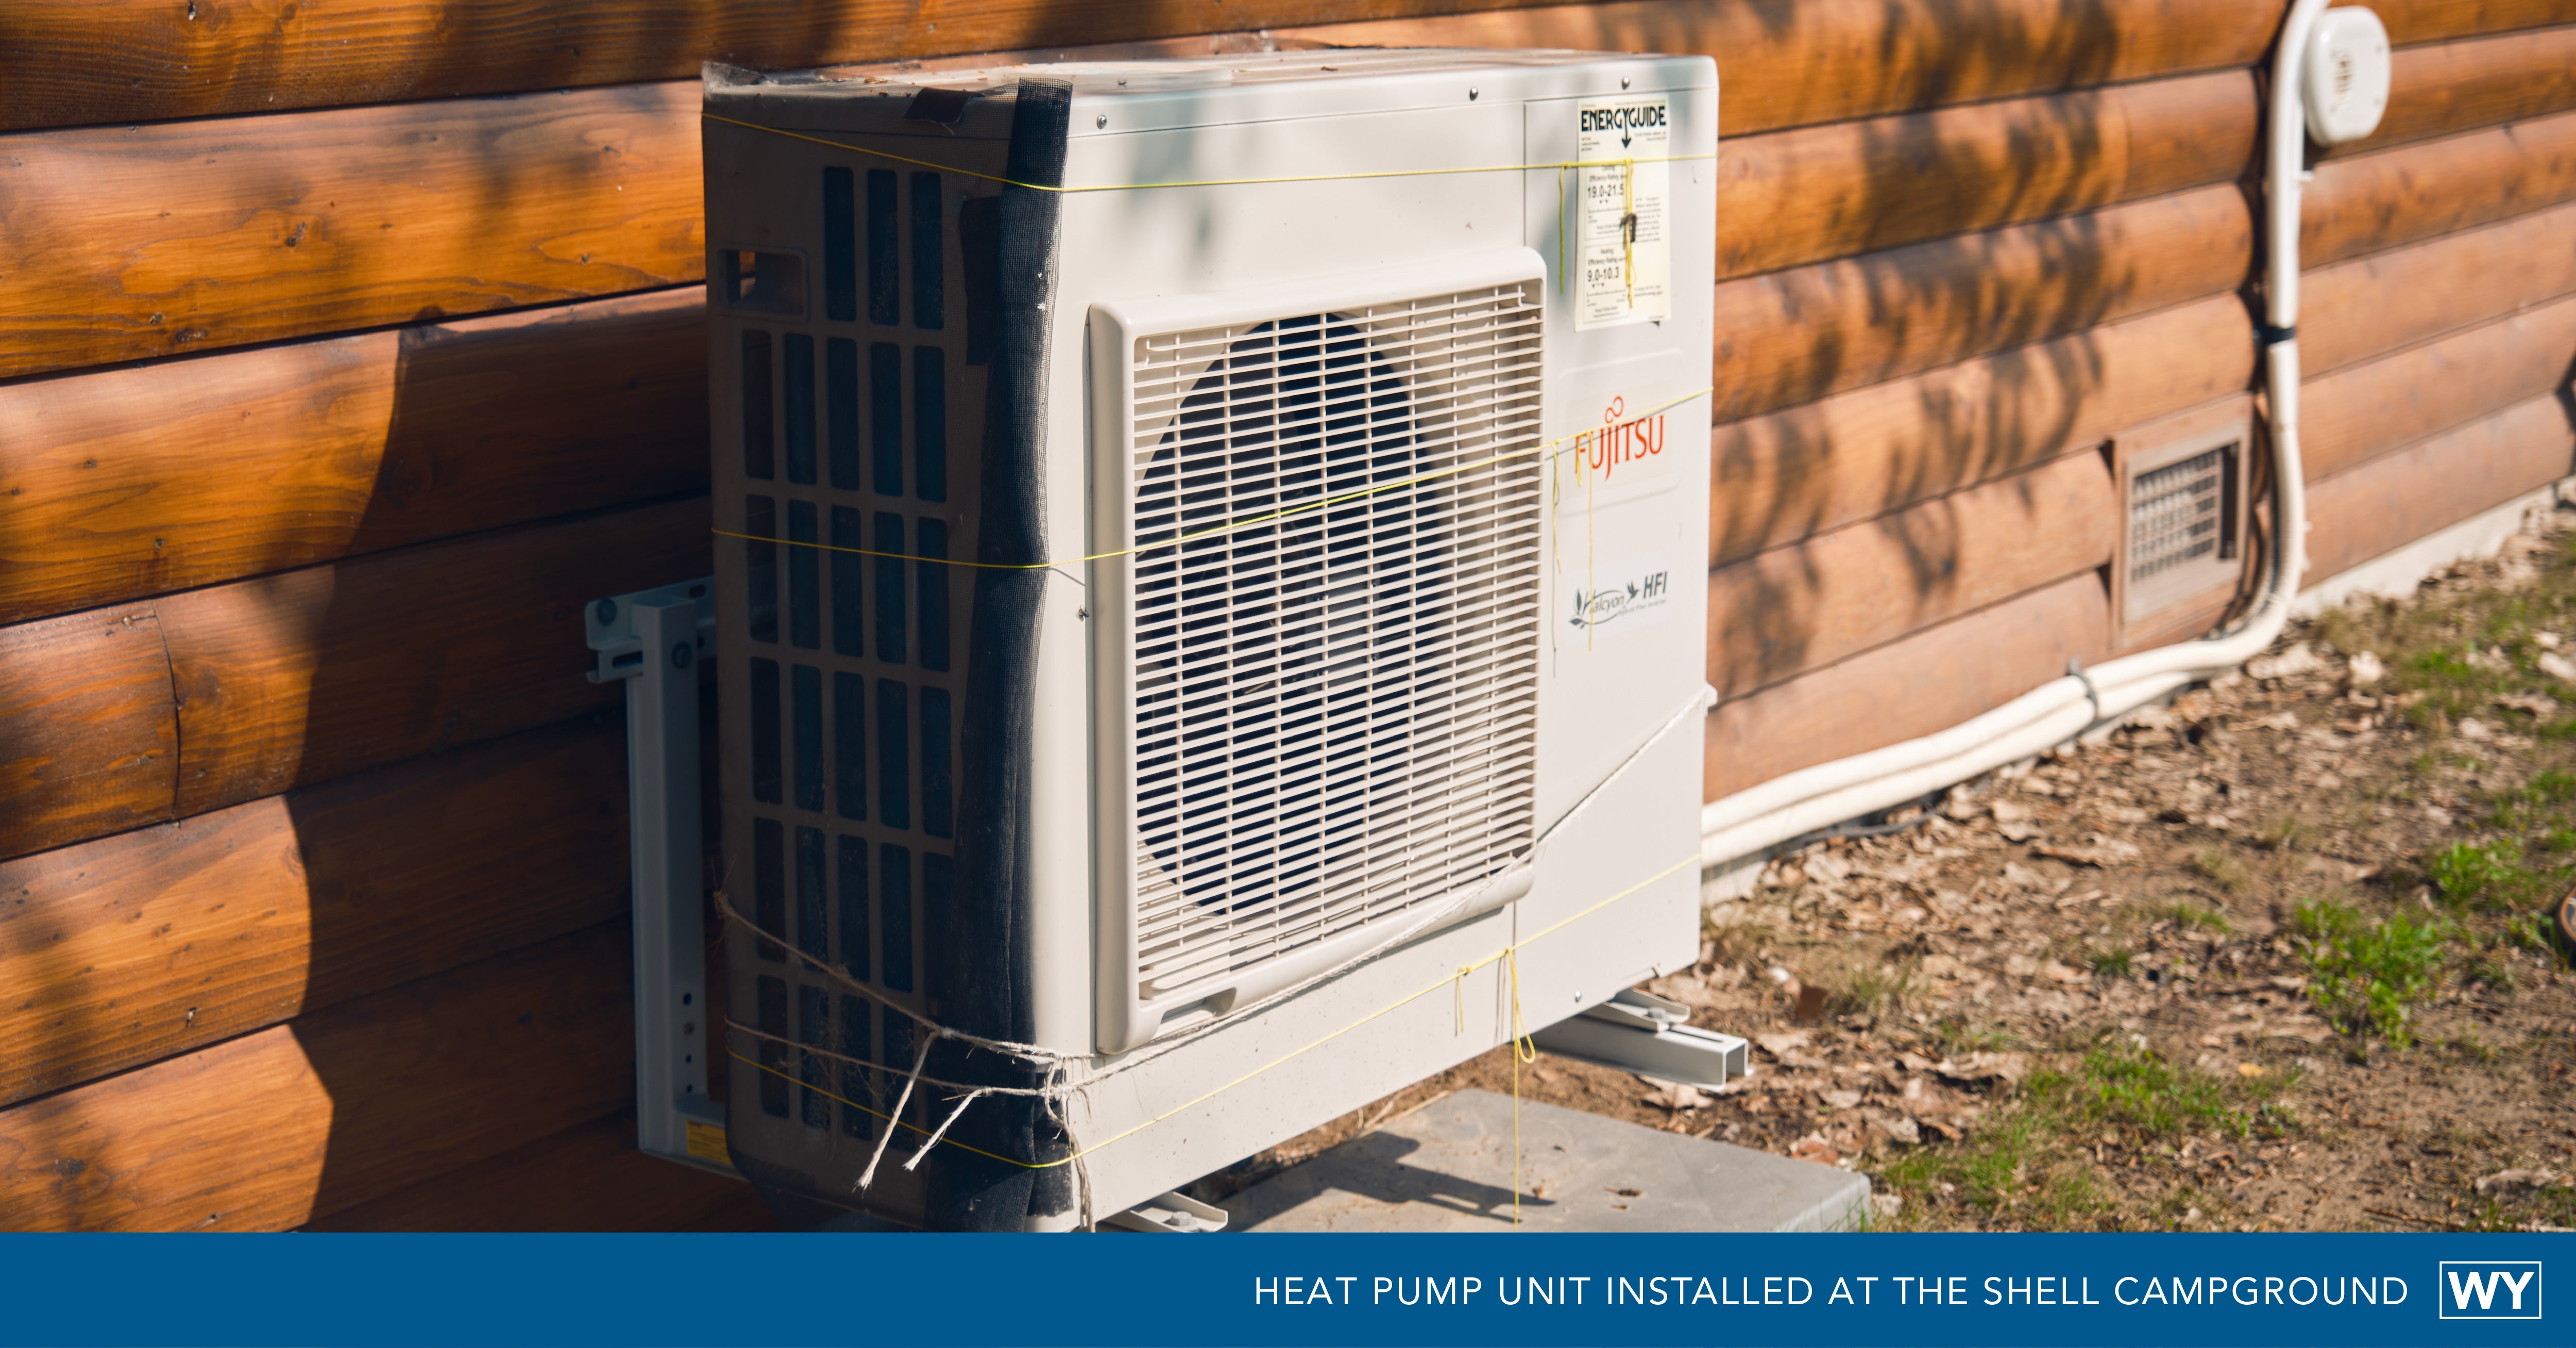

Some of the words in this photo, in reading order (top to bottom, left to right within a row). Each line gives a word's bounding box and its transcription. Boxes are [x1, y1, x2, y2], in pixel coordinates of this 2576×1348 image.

[1582, 106, 1666, 131] ENERGYGUIDE
[1587, 266, 1620, 282] 9.0-10.3
[1575, 414, 1664, 482] FUJITSU
[1643, 570, 1668, 600] HFI
